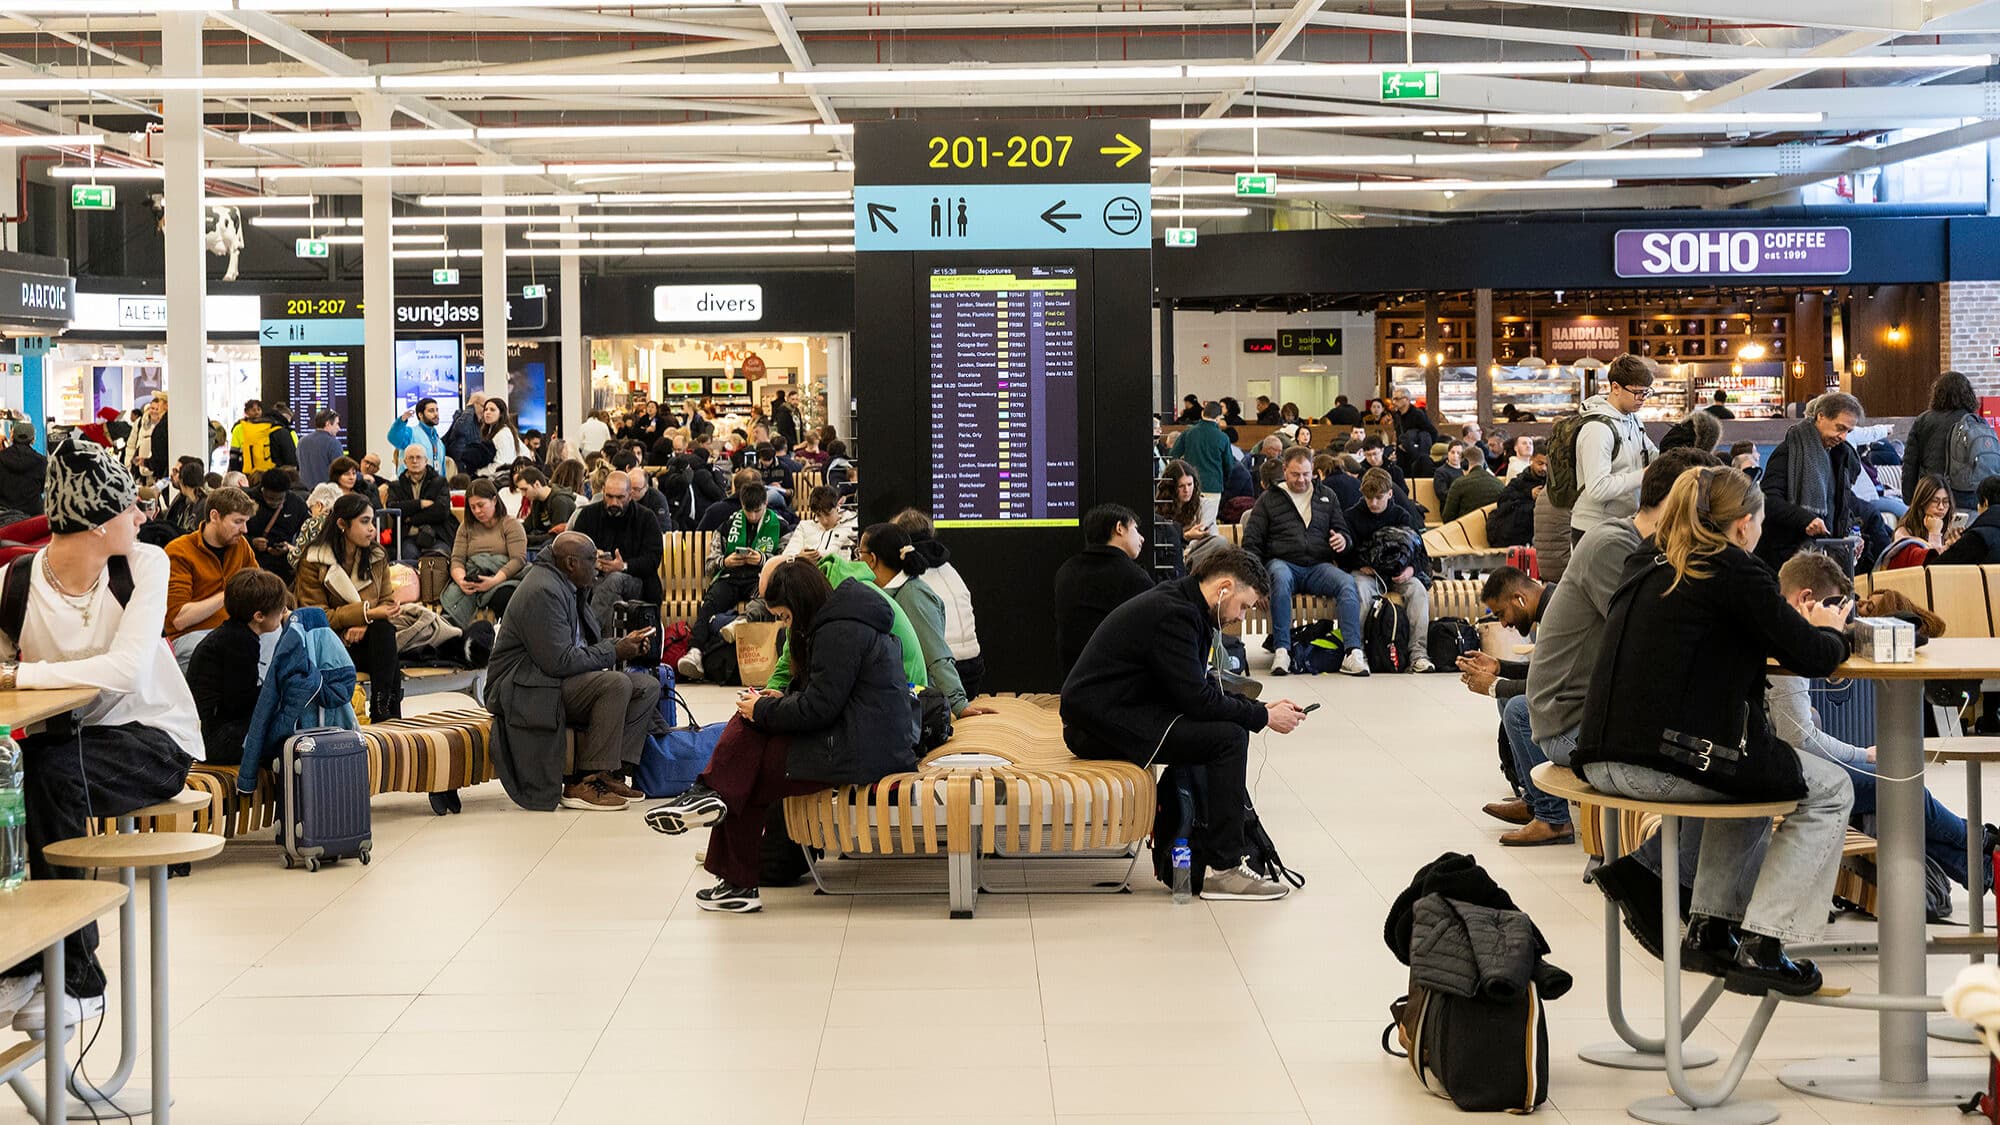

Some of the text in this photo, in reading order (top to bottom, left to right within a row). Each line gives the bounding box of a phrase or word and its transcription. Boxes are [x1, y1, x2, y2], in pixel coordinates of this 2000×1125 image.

[929, 135, 1072, 169] 201-207
[1642, 231, 1826, 273] SOHO COFFEE
[1764, 250, 1807, 260] est 1999
[22, 282, 66, 310] PARFOIS
[696, 291, 756, 312] divers
[287, 299, 346, 315] 201-207
[397, 300, 479, 327] sunglass
[1552, 327, 1619, 340] HANDMADE
[1552, 340, 1619, 350] GOOD MOOD FOOD
